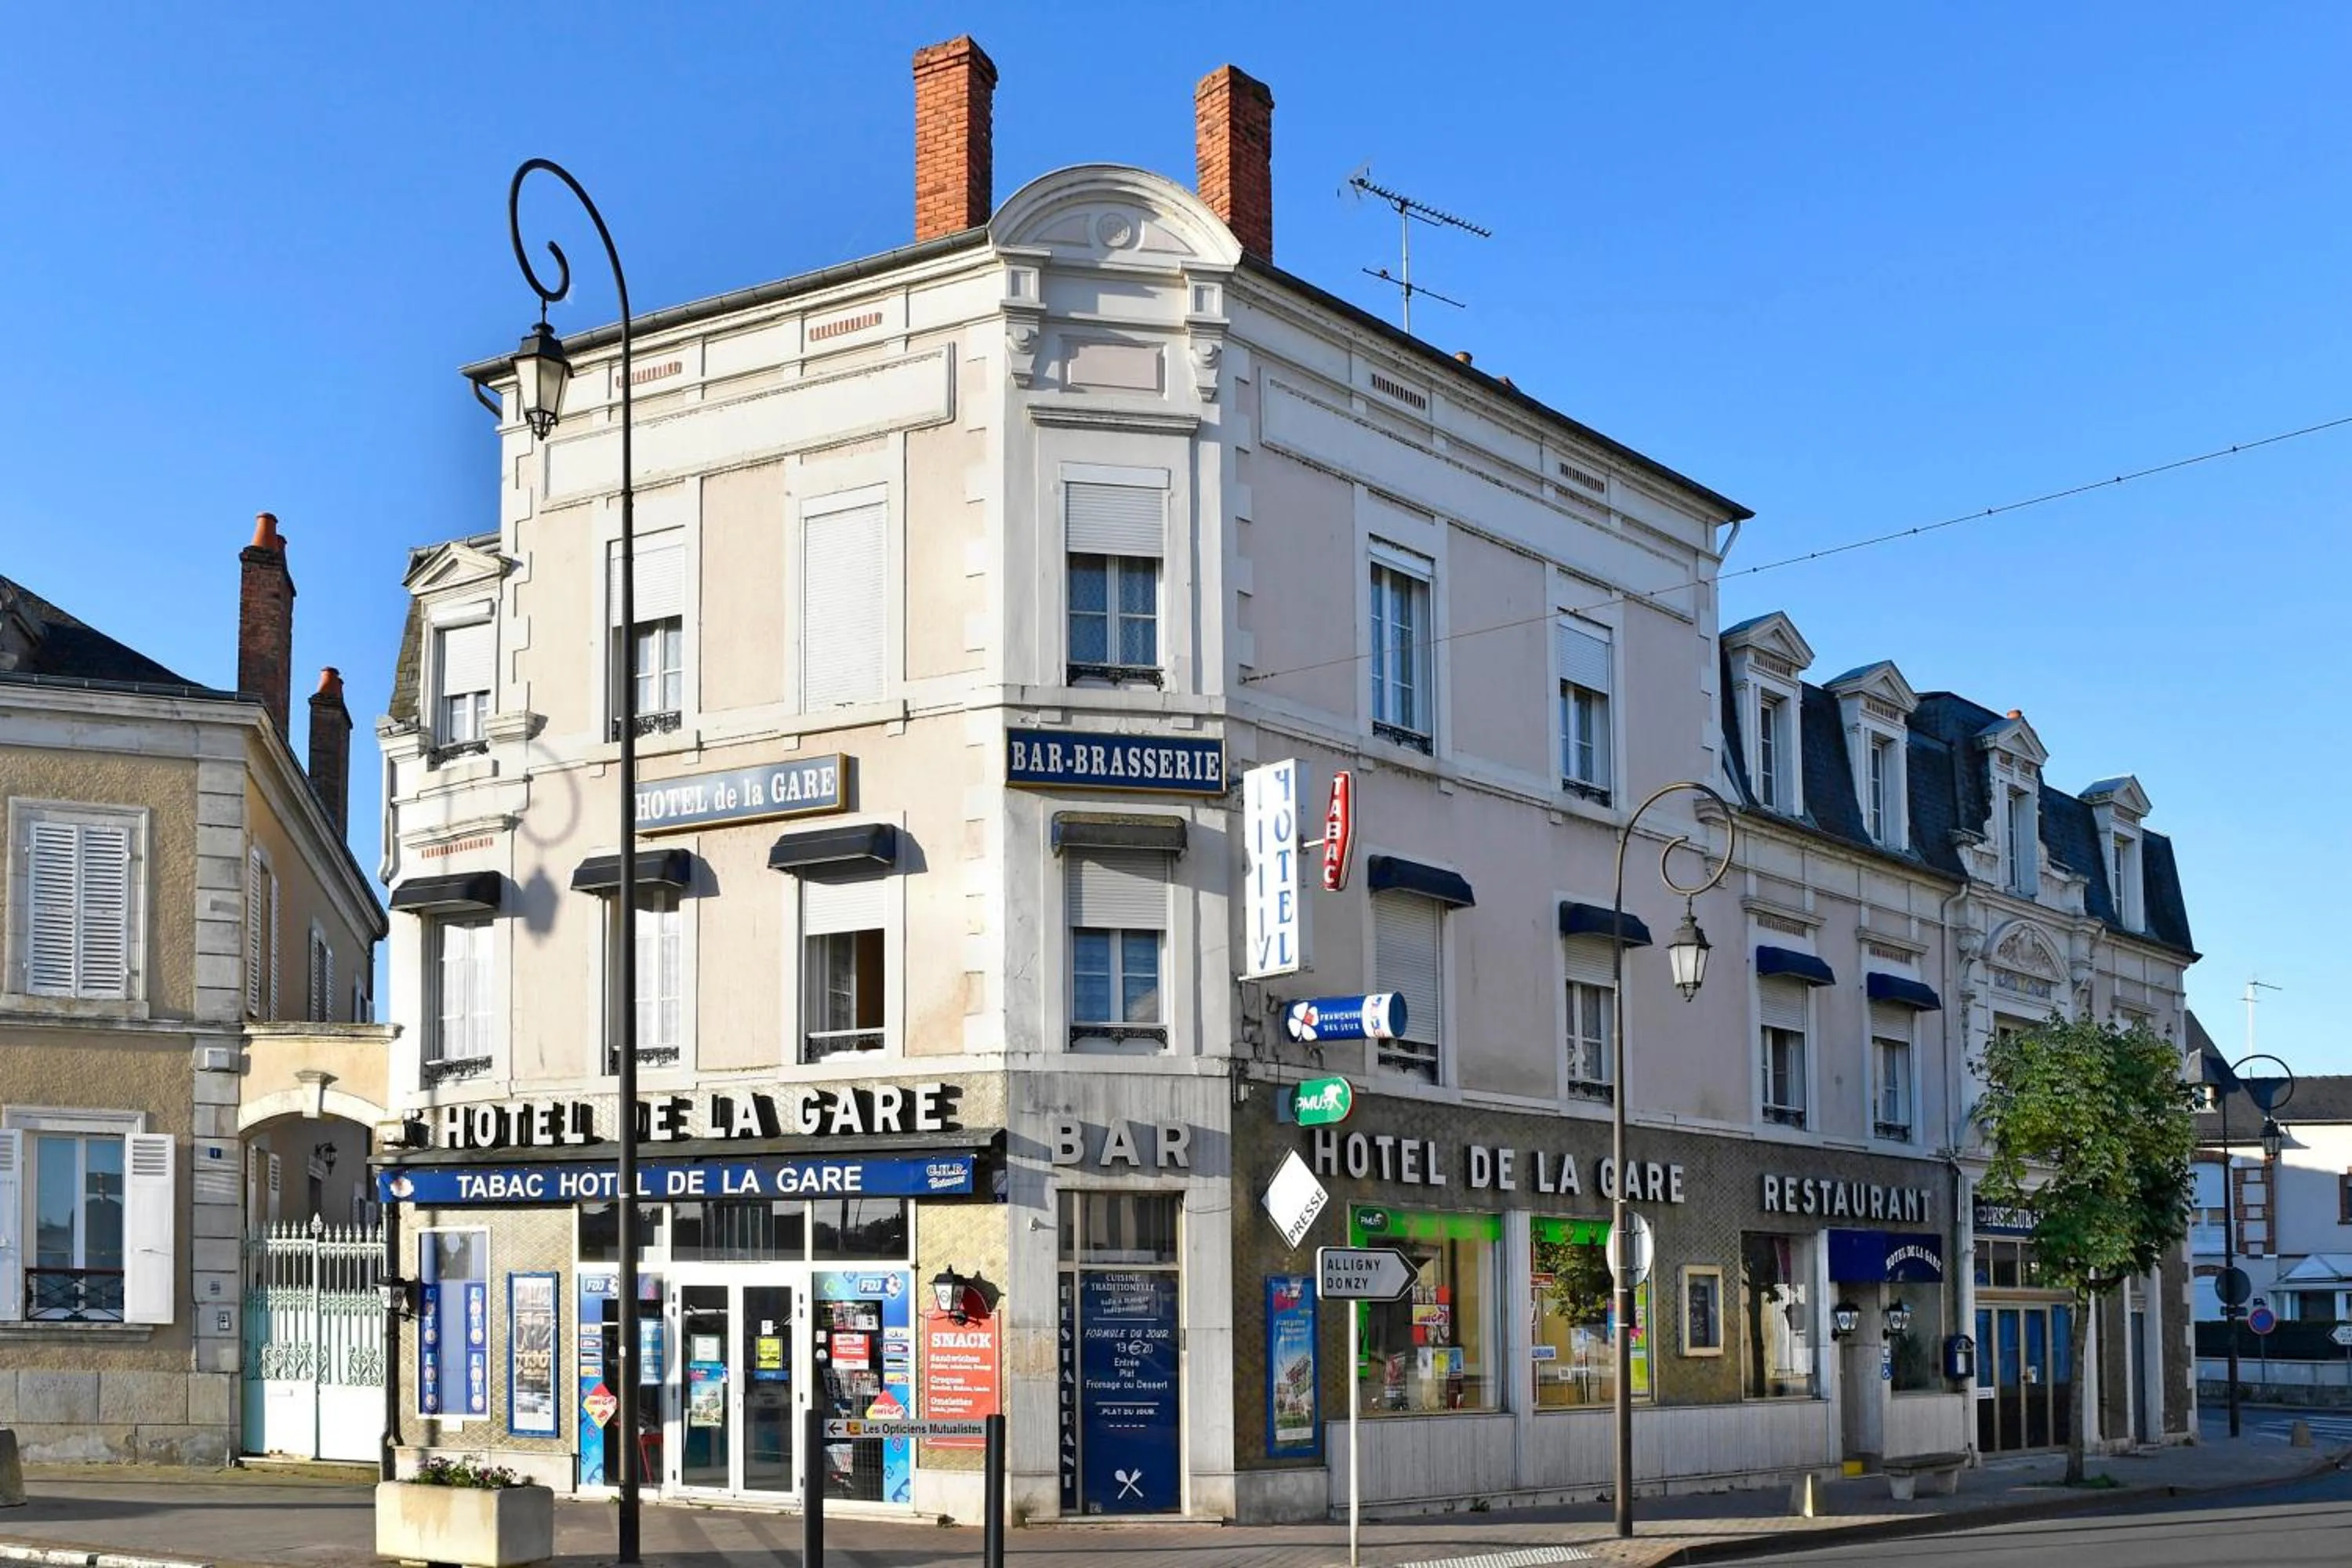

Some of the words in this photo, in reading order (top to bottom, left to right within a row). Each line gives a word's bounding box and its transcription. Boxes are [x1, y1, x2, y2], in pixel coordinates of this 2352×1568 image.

[1011, 741, 1220, 781] BAR-BRASSERIE
[636, 786, 708, 821] HOTEL
[714, 782, 738, 811] de
[745, 777, 764, 808] la
[771, 766, 836, 804] GARE
[1323, 777, 1344, 884] TABAC
[1295, 1094, 1324, 1112] PMU
[444, 1101, 586, 1149] HOTEL
[706, 1094, 763, 1138] LA
[794, 1082, 943, 1135] GARE
[1051, 1118, 1191, 1167] BAR
[1314, 1127, 1446, 1186] HOTEL
[1469, 1145, 1515, 1190] DE
[1537, 1151, 1581, 1195] LA
[1599, 1156, 1686, 1203] GARE
[457, 1174, 543, 1198] TABAC
[559, 1171, 652, 1198] HOTL
[666, 1171, 705, 1194] DE
[723, 1169, 760, 1193] LA
[777, 1166, 862, 1192] GARE
[1764, 1175, 1932, 1222] RESTAURANT
[1288, 1187, 1327, 1243] PRESSE
[1327, 1259, 1381, 1271] ALLIGNY
[586, 1279, 604, 1292] FDJ
[861, 1279, 881, 1292] FDJ
[1327, 1278, 1368, 1289] DONZY
[931, 1332, 992, 1348] SNACK
[1085, 1329, 1126, 1338] FORMULE
[1131, 1329, 1142, 1338] DU
[1145, 1329, 1169, 1338] JOUR
[1114, 1357, 1140, 1367] Entrée
[1119, 1368, 1134, 1377] Plat
[1061, 1286, 1075, 1488] RESTAURANT
[1086, 1380, 1120, 1390] Fromage
[1136, 1380, 1167, 1389] Dessert
[863, 1424, 879, 1433] Les
[882, 1424, 927, 1436] Opticiens
[930, 1423, 982, 1434] Mutualistes
